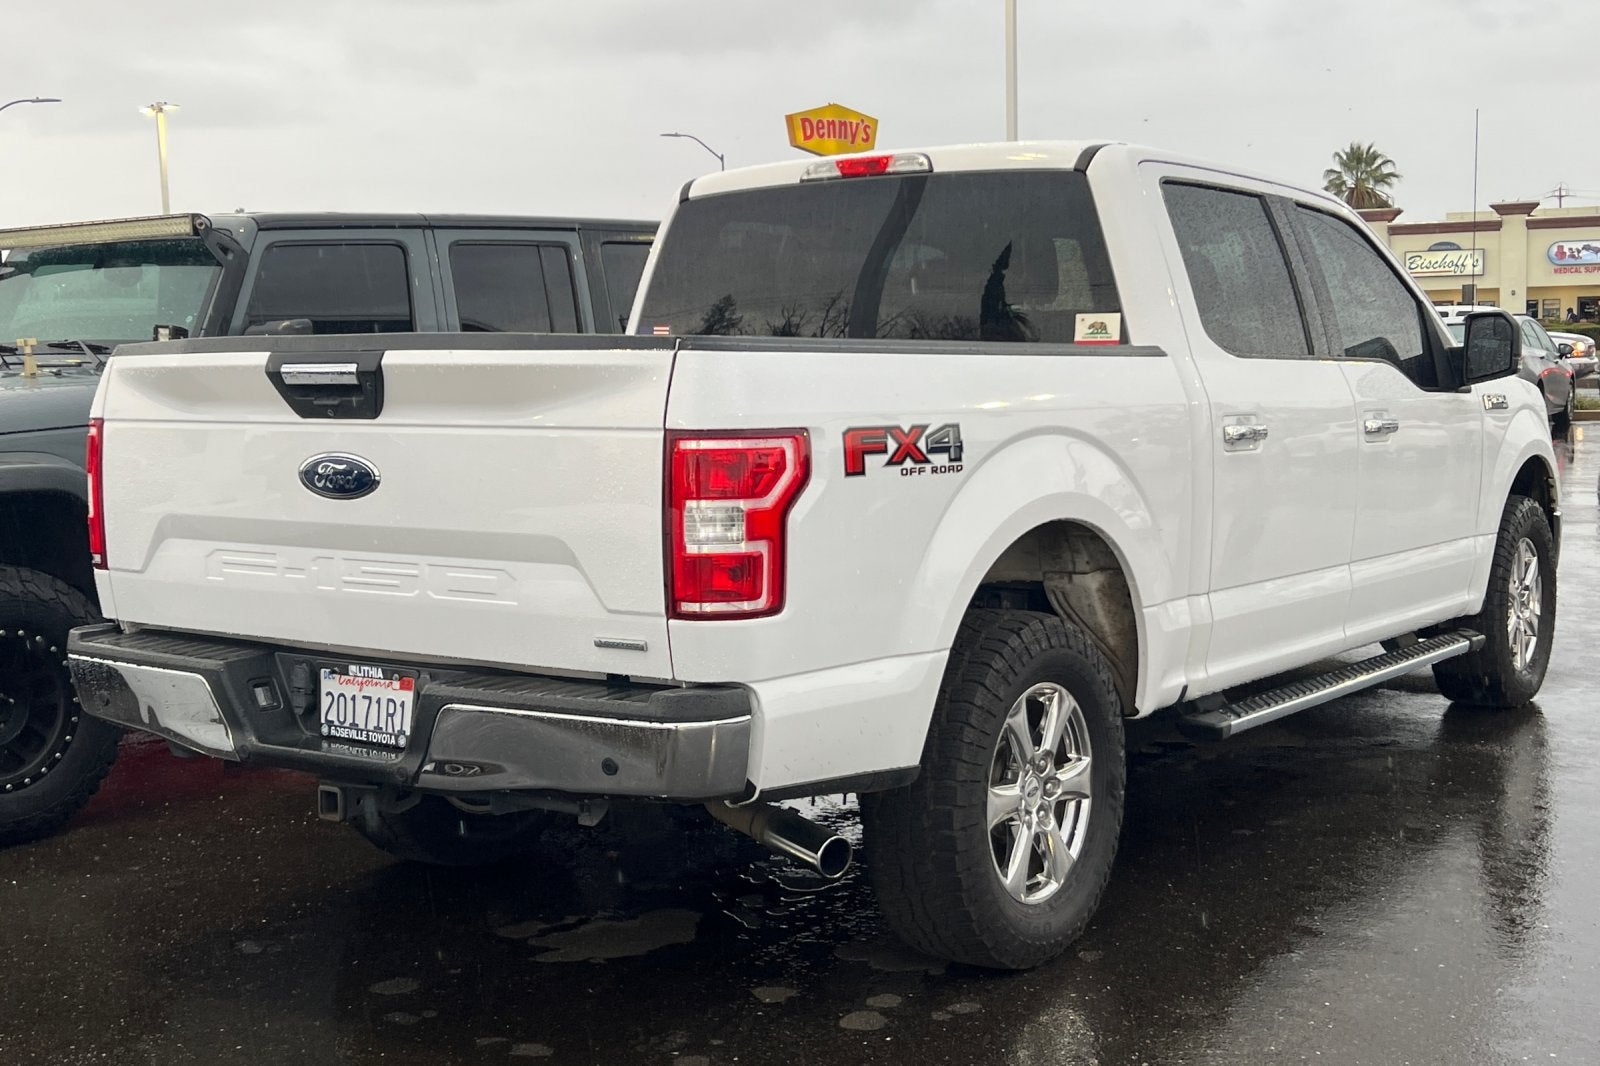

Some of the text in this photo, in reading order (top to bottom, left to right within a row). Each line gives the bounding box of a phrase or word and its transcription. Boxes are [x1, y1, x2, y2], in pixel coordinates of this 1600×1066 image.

[799, 117, 871, 145] Denny's
[1407, 253, 1479, 273] Bischoff's
[842, 423, 963, 477] FX4
[314, 462, 359, 489] Ford
[900, 464, 963, 476] OFF ROAD
[205, 548, 518, 605] F-150
[338, 673, 394, 692] California
[356, 665, 384, 679] LITHIA
[324, 690, 406, 736] 20171R1
[330, 726, 396, 745] ROSEVILLE TOYOTA
